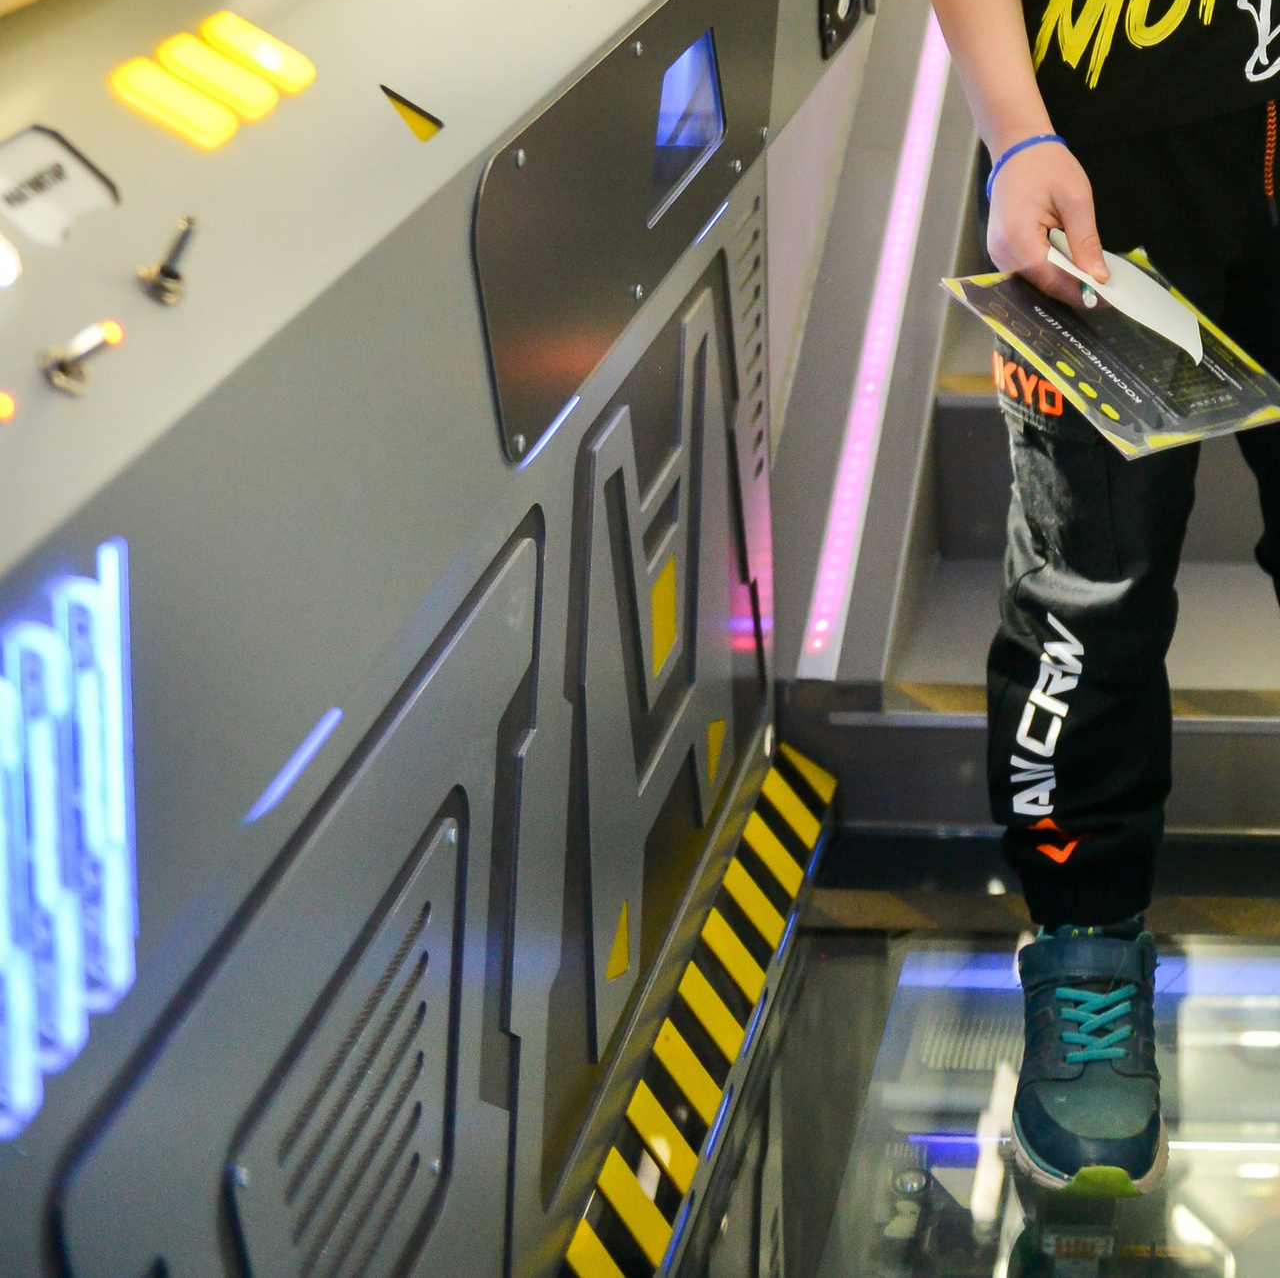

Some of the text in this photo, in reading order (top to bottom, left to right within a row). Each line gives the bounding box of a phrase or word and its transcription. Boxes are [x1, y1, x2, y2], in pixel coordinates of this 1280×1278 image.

[1034, 305, 1063, 330] ЦЕЛЬ
[992, 348, 1064, 418] KYO
[1062, 330, 1143, 403] КОСМИЧЕСКАЯ
